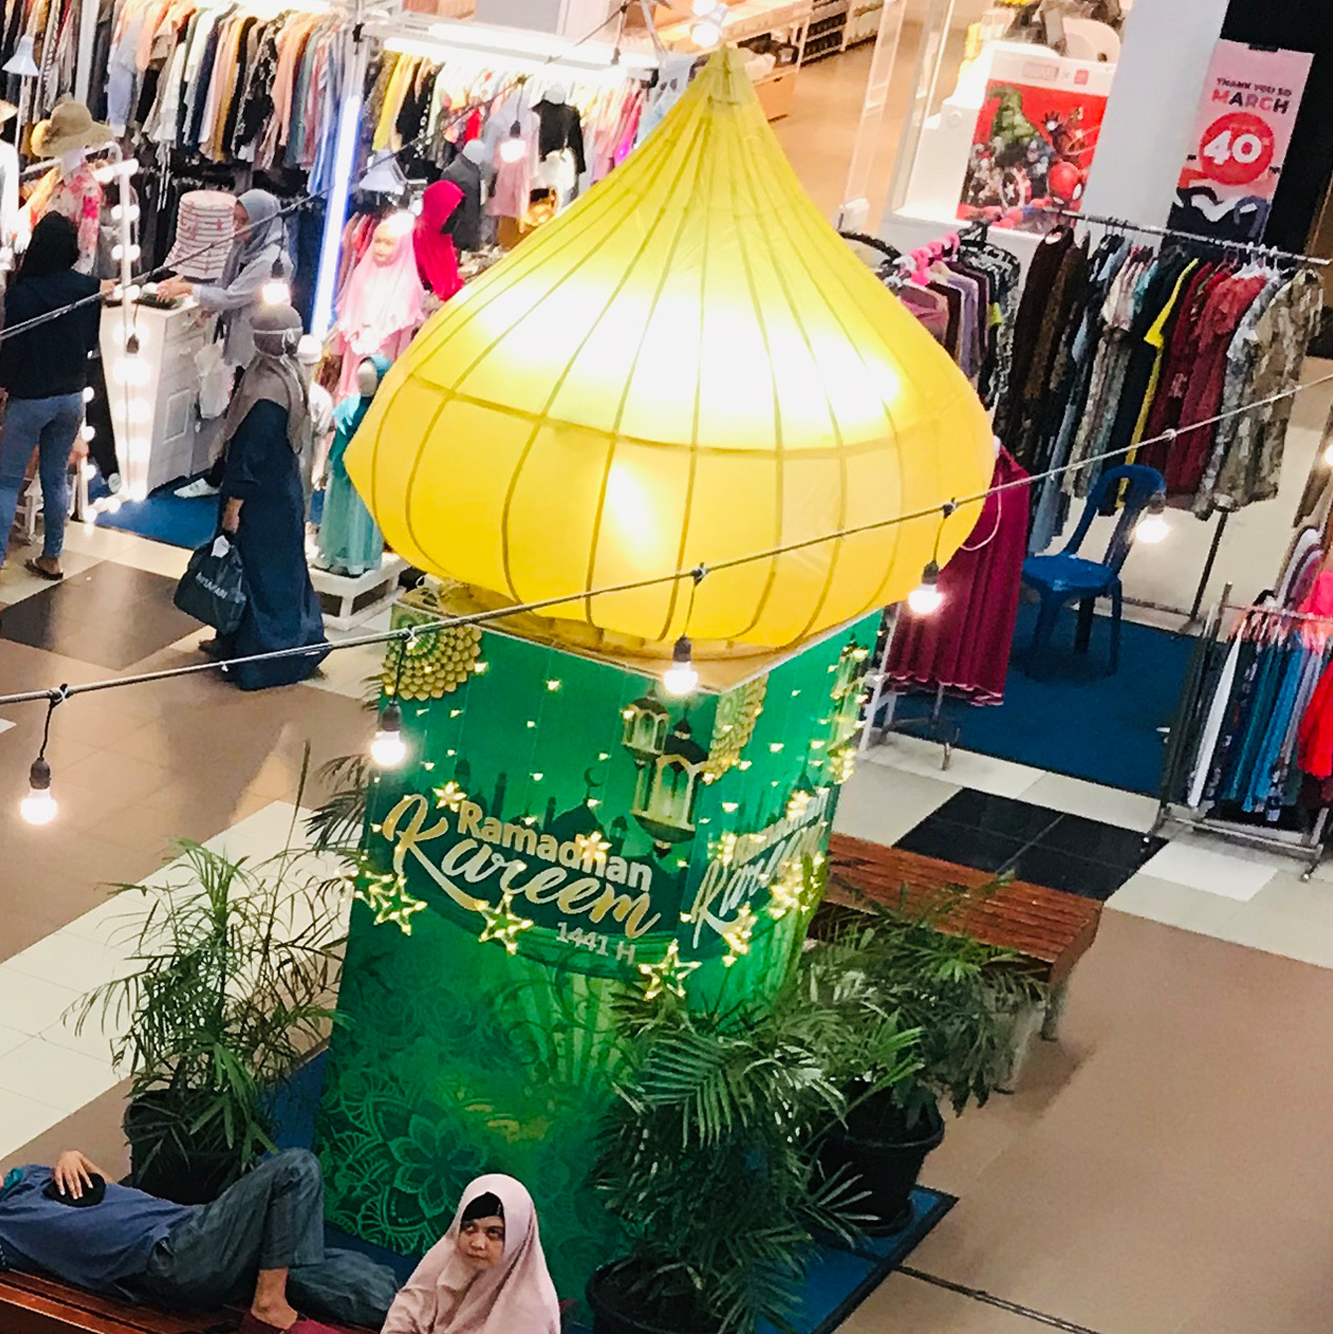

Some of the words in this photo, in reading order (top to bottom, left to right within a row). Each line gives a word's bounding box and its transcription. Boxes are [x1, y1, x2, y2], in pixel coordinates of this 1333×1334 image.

[1211, 89, 1290, 114] MARCH
[1217, 77, 1252, 91] THANK
[1254, 84, 1275, 95] YOU
[1277, 87, 1292, 97] SO
[1203, 130, 1262, 166] 40
[383, 794, 661, 938] Kareem
[555, 921, 608, 955] 1441
